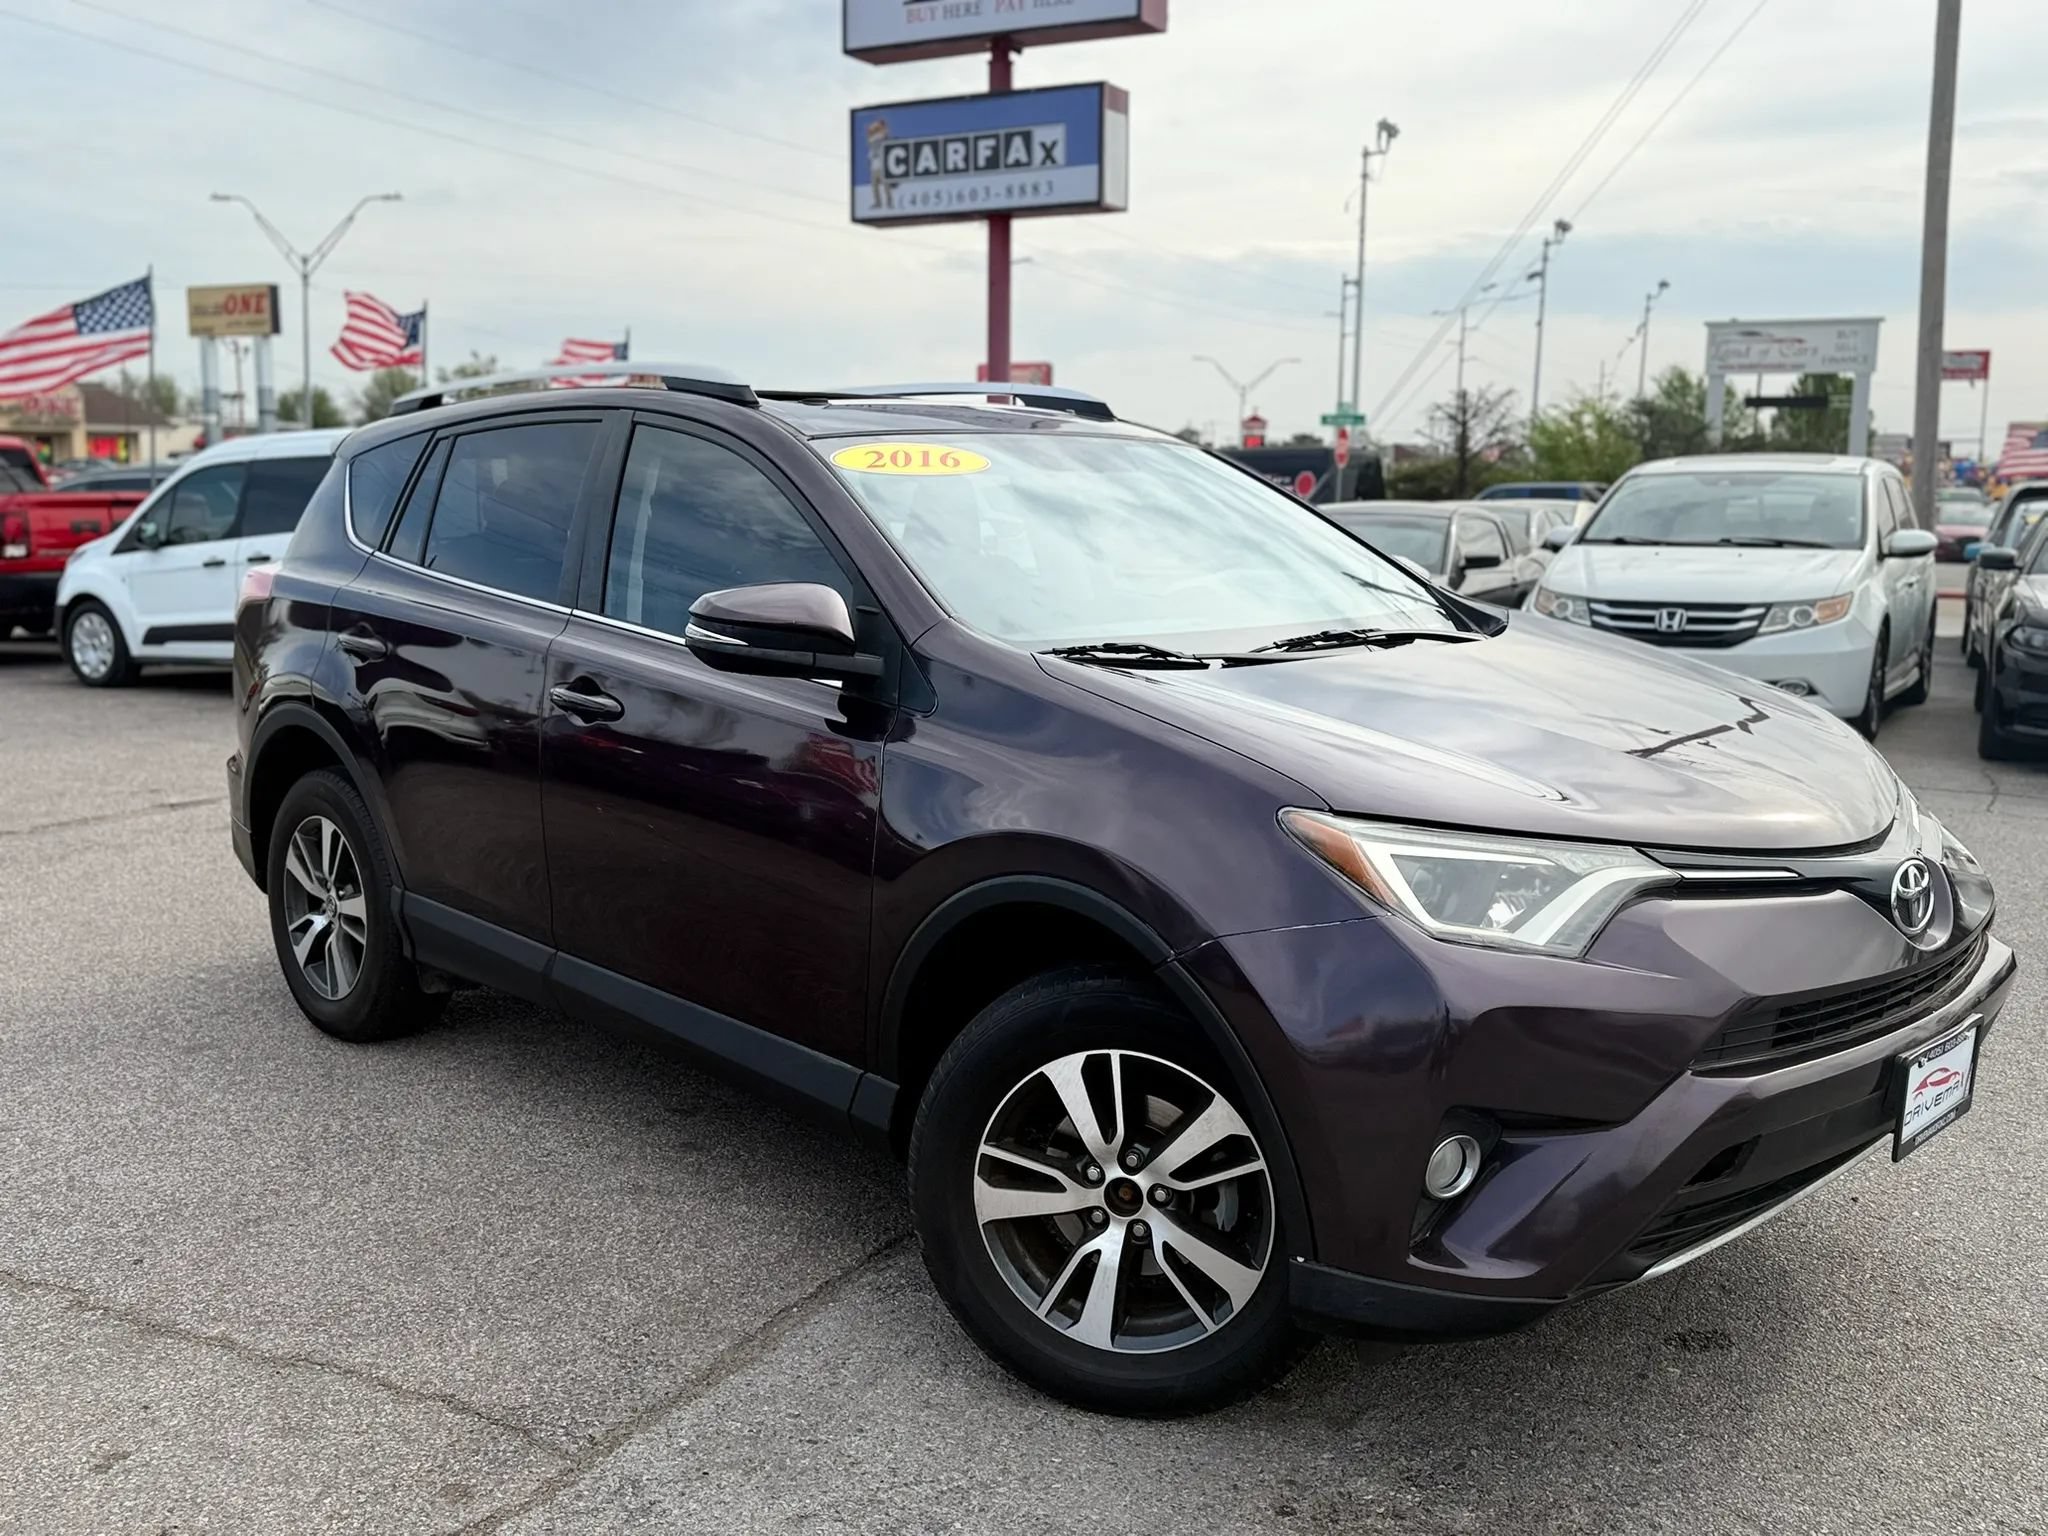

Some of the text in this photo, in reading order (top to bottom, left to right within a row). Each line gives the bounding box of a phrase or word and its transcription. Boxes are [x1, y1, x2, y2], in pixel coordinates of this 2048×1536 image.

[905, 5, 938, 24] BUY
[942, 1, 983, 20] HERE
[994, 0, 1025, 14] PAY
[885, 130, 1060, 178] CARFAX
[223, 291, 267, 316] ONE
[863, 449, 962, 469] 2016
